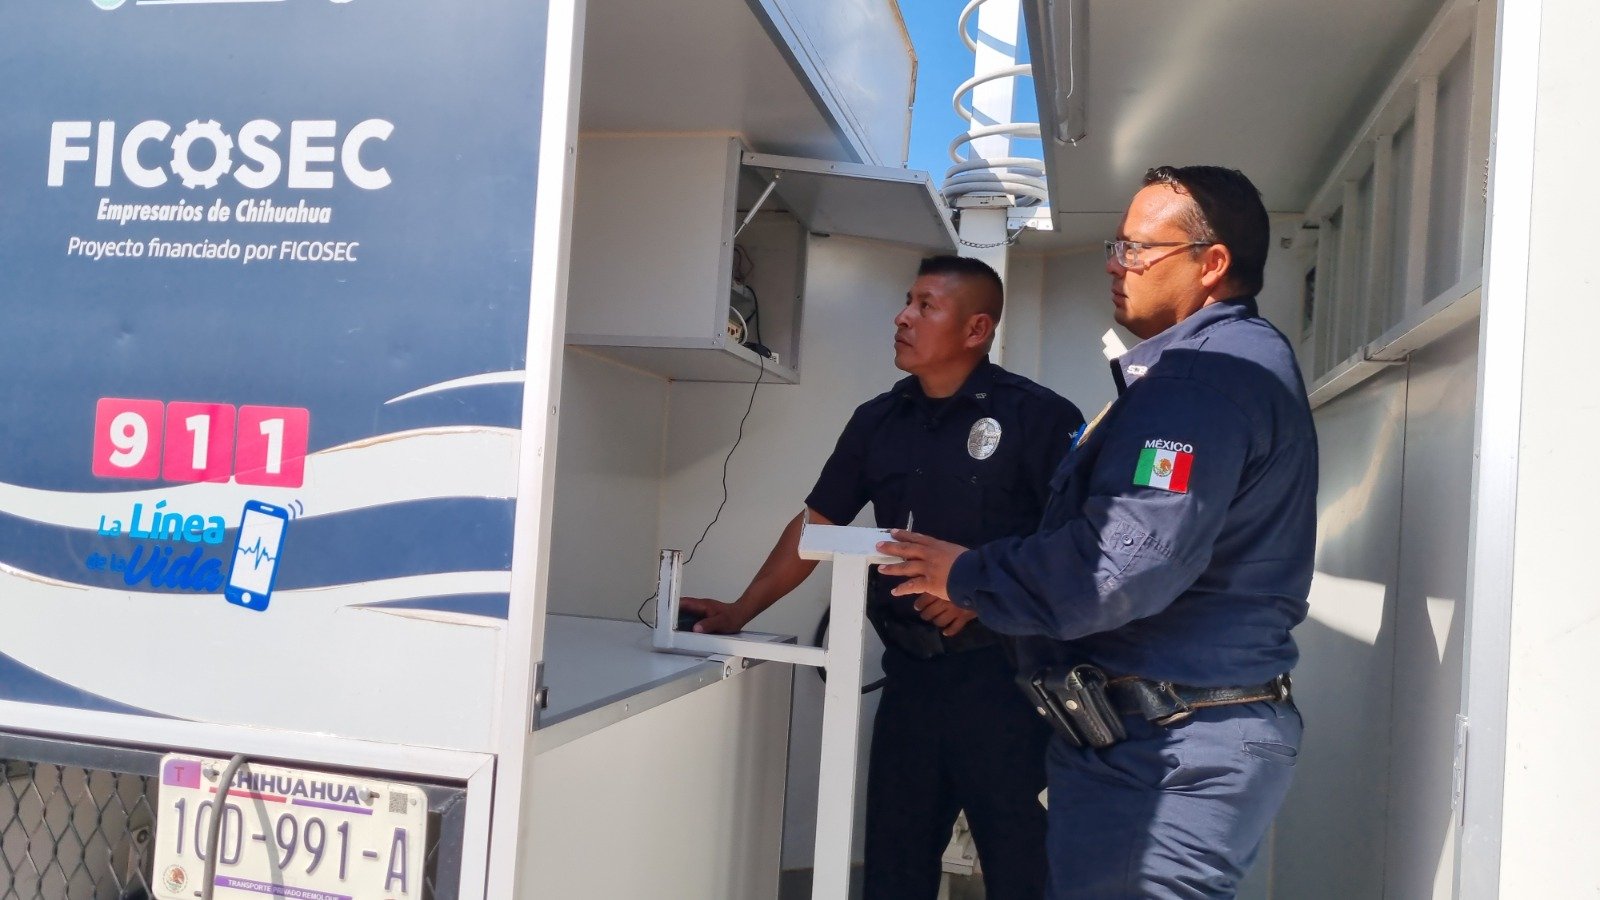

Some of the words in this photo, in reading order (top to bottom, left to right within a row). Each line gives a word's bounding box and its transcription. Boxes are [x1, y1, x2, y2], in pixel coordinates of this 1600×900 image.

[47, 118, 395, 190] FICOSEC
[96, 197, 203, 226] Empresarios
[207, 198, 231, 222] de
[235, 198, 332, 224] Chihuahua
[67, 236, 144, 260] Proyecto
[148, 237, 241, 260] financiado
[242, 243, 277, 264] por
[279, 240, 360, 262] FICOSEC
[108, 411, 285, 475] 911
[1144, 438, 1193, 454] MÉXICO
[97, 515, 122, 537] La
[129, 499, 226, 545] Línea
[86, 552, 107, 572] de
[110, 553, 128, 572] la
[124, 544, 226, 592] Vida
[174, 766, 184, 782] T
[229, 769, 361, 805] HIHUAHUA
[228, 879, 272, 893] TRANSPORTE
[272, 886, 302, 898] PRIVADO
